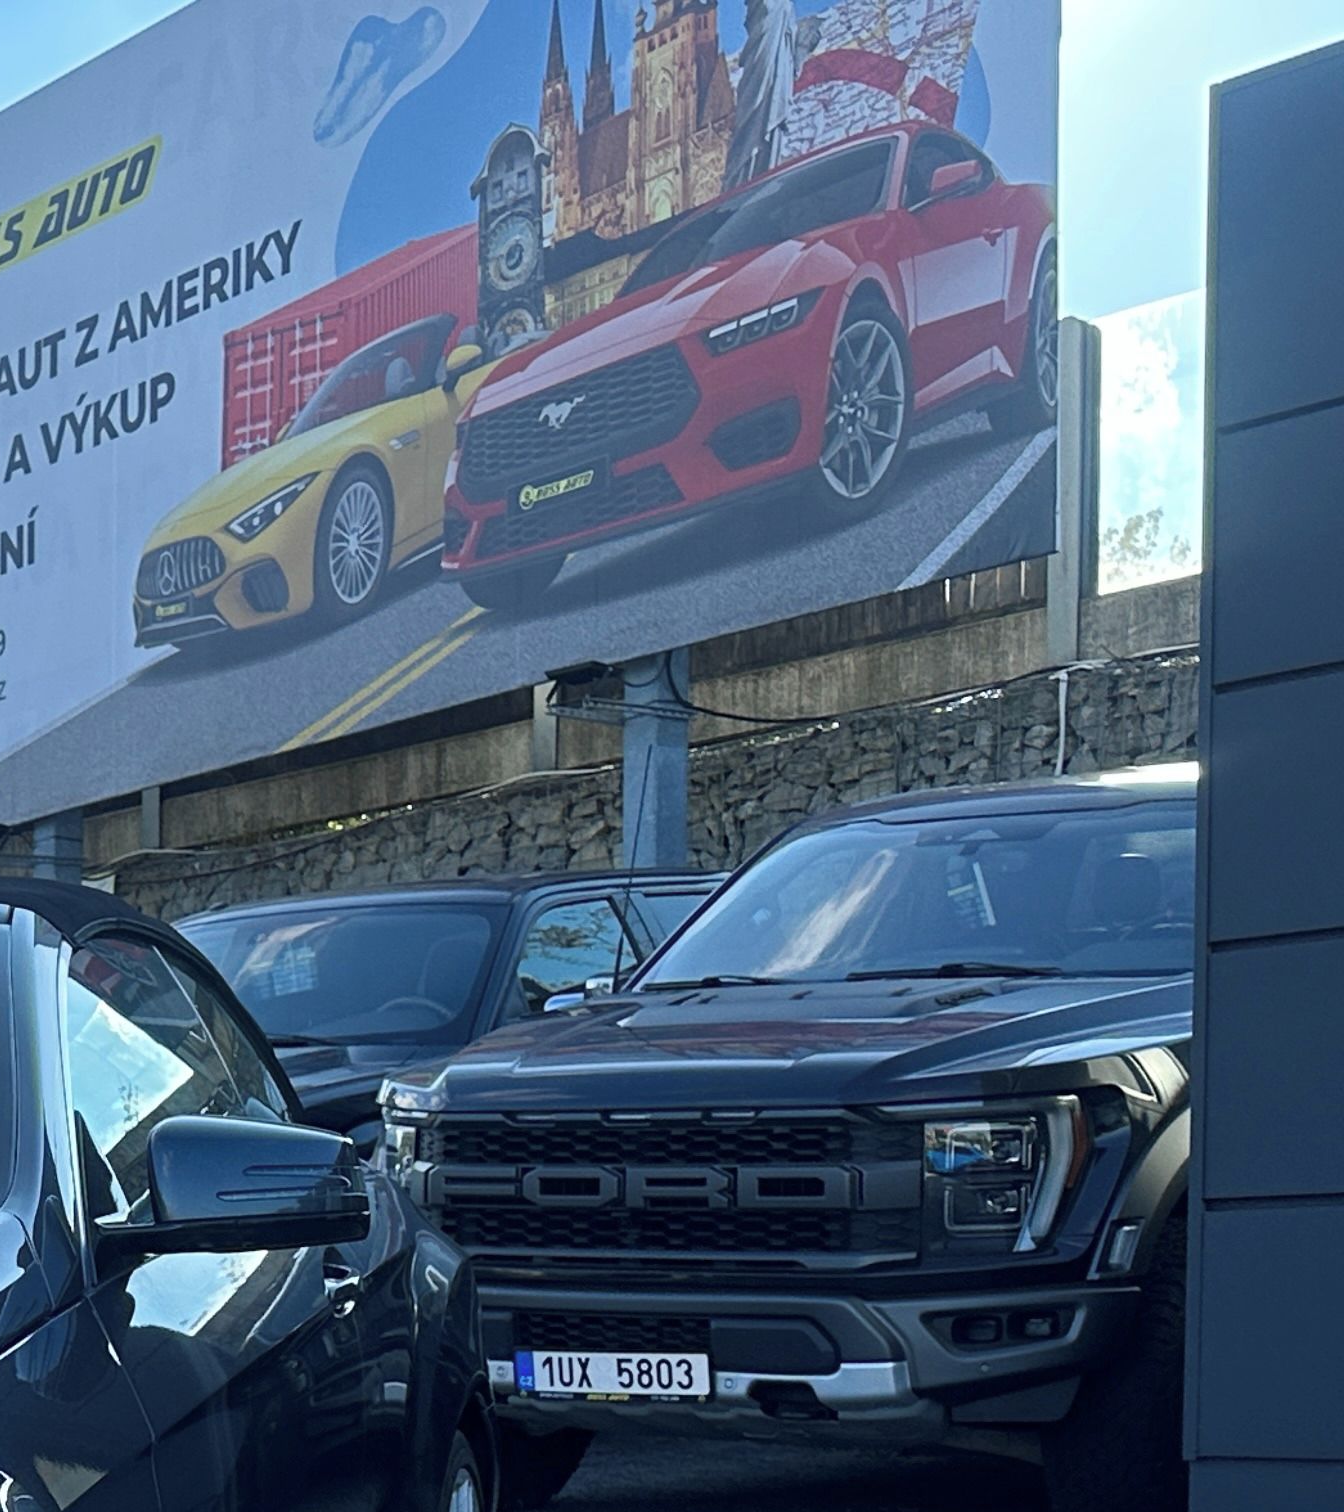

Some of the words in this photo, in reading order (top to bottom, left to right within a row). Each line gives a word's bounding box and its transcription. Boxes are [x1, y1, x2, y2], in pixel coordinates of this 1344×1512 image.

[32, 144, 156, 250] AUTO
[74, 313, 100, 368] Z
[107, 219, 303, 354] AMERIKY
[3, 433, 32, 484] A
[40, 372, 176, 465] VÝKUP
[426, 1164, 853, 1208] FORD
[542, 1356, 593, 1388] 1UX
[616, 1358, 694, 1390] 5803
